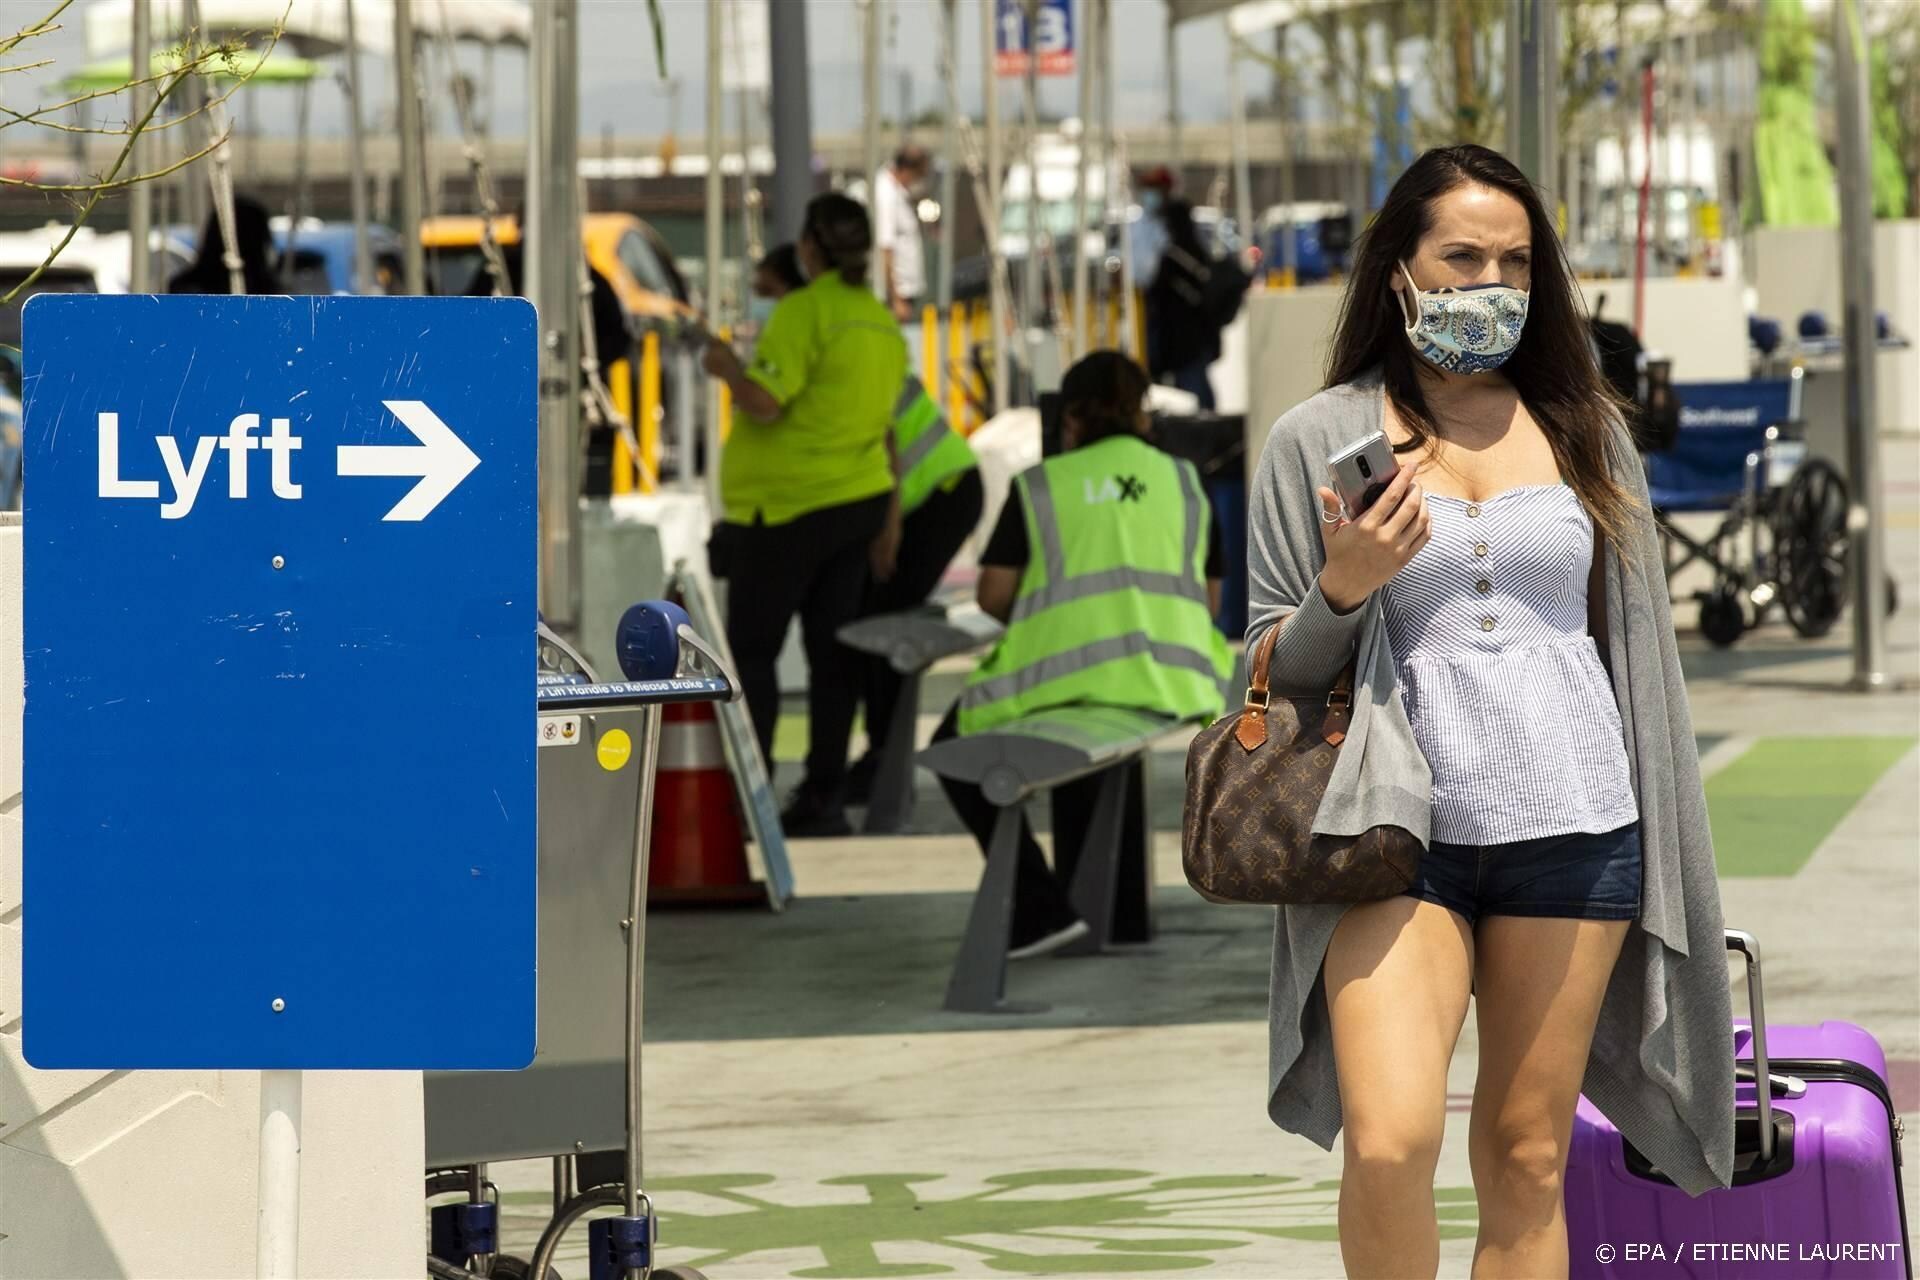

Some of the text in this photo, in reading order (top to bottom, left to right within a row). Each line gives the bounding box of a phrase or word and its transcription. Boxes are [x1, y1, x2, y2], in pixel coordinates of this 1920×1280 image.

[98, 412, 303, 520] Lyft
[546, 685, 566, 697] Lift
[567, 682, 609, 696] Handle
[611, 684, 625, 694] to
[624, 681, 669, 693] Release
[669, 679, 704, 690] Brake
